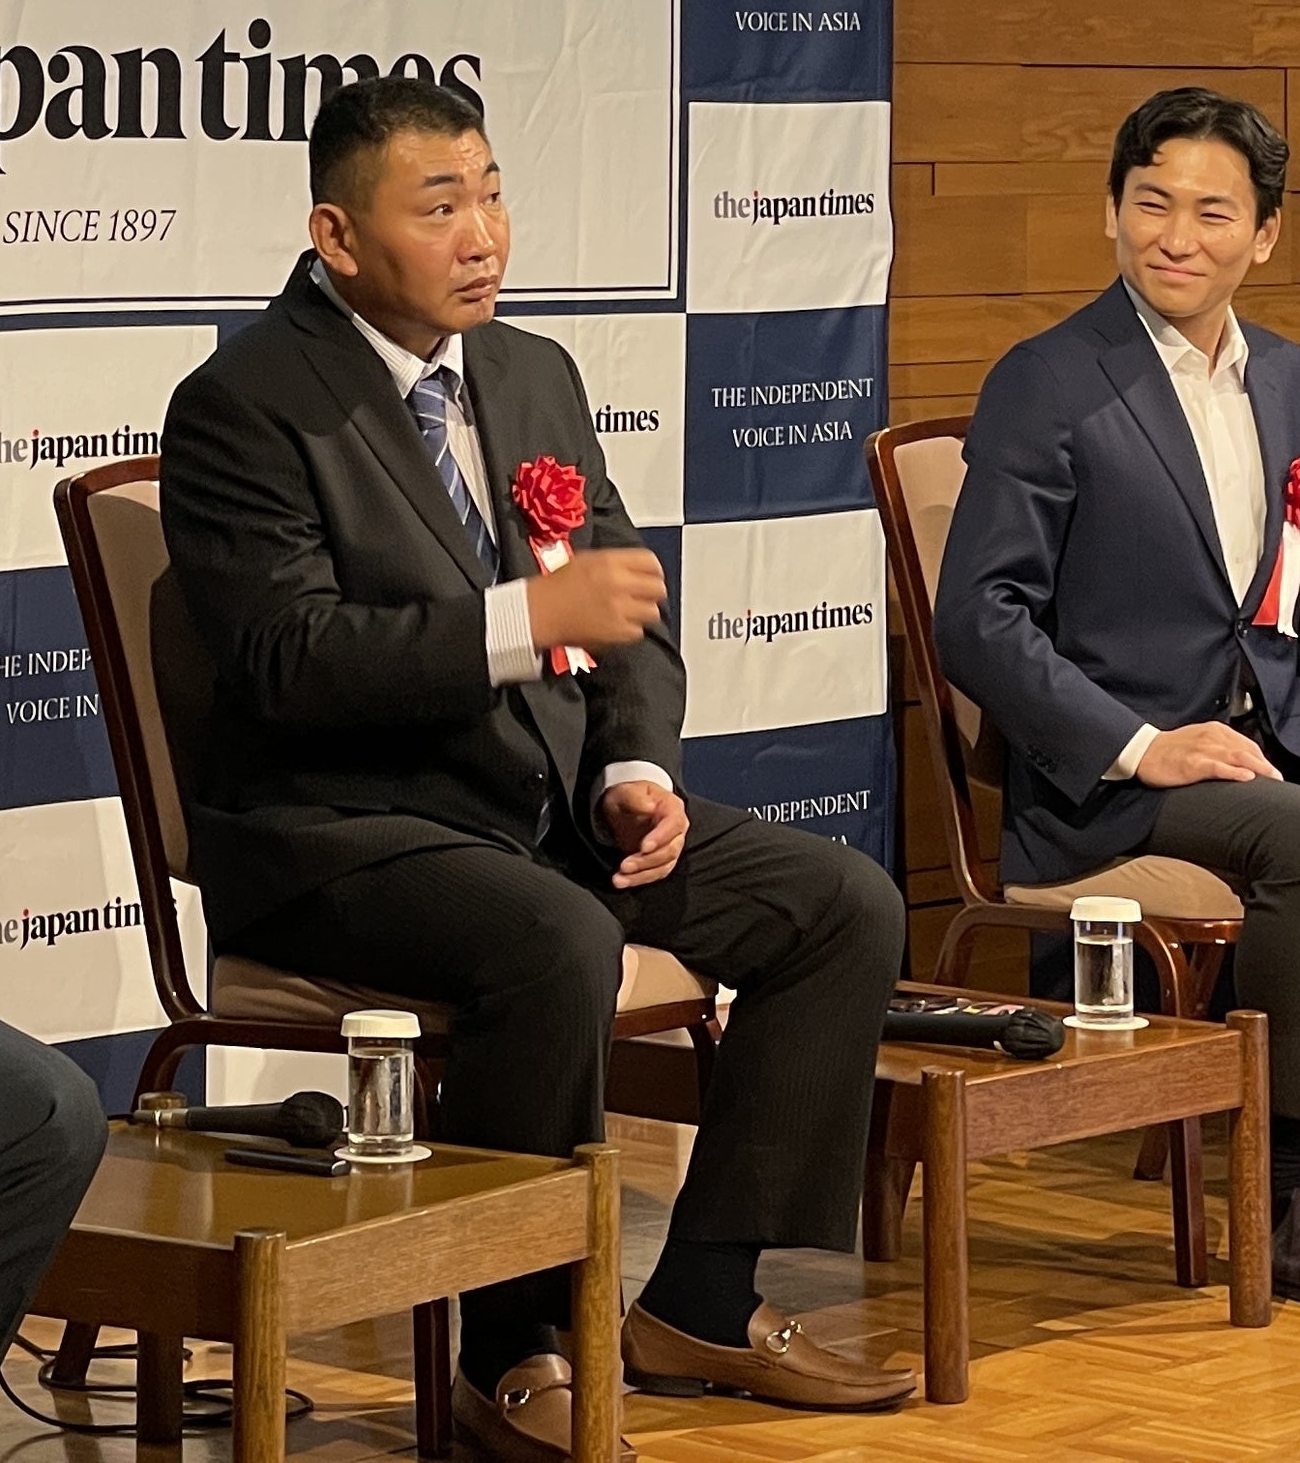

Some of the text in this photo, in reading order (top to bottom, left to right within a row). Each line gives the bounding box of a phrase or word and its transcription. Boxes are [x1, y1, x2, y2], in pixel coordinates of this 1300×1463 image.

[734, 9, 862, 34] VOICE IN ASIA
[1, 208, 178, 245] SINCE 1897
[711, 377, 875, 409] THE INDEPENDENT
[595, 404, 660, 434] times
[731, 420, 854, 450] VOICE IN ASIA
[5, 693, 100, 724] VOICE IN
